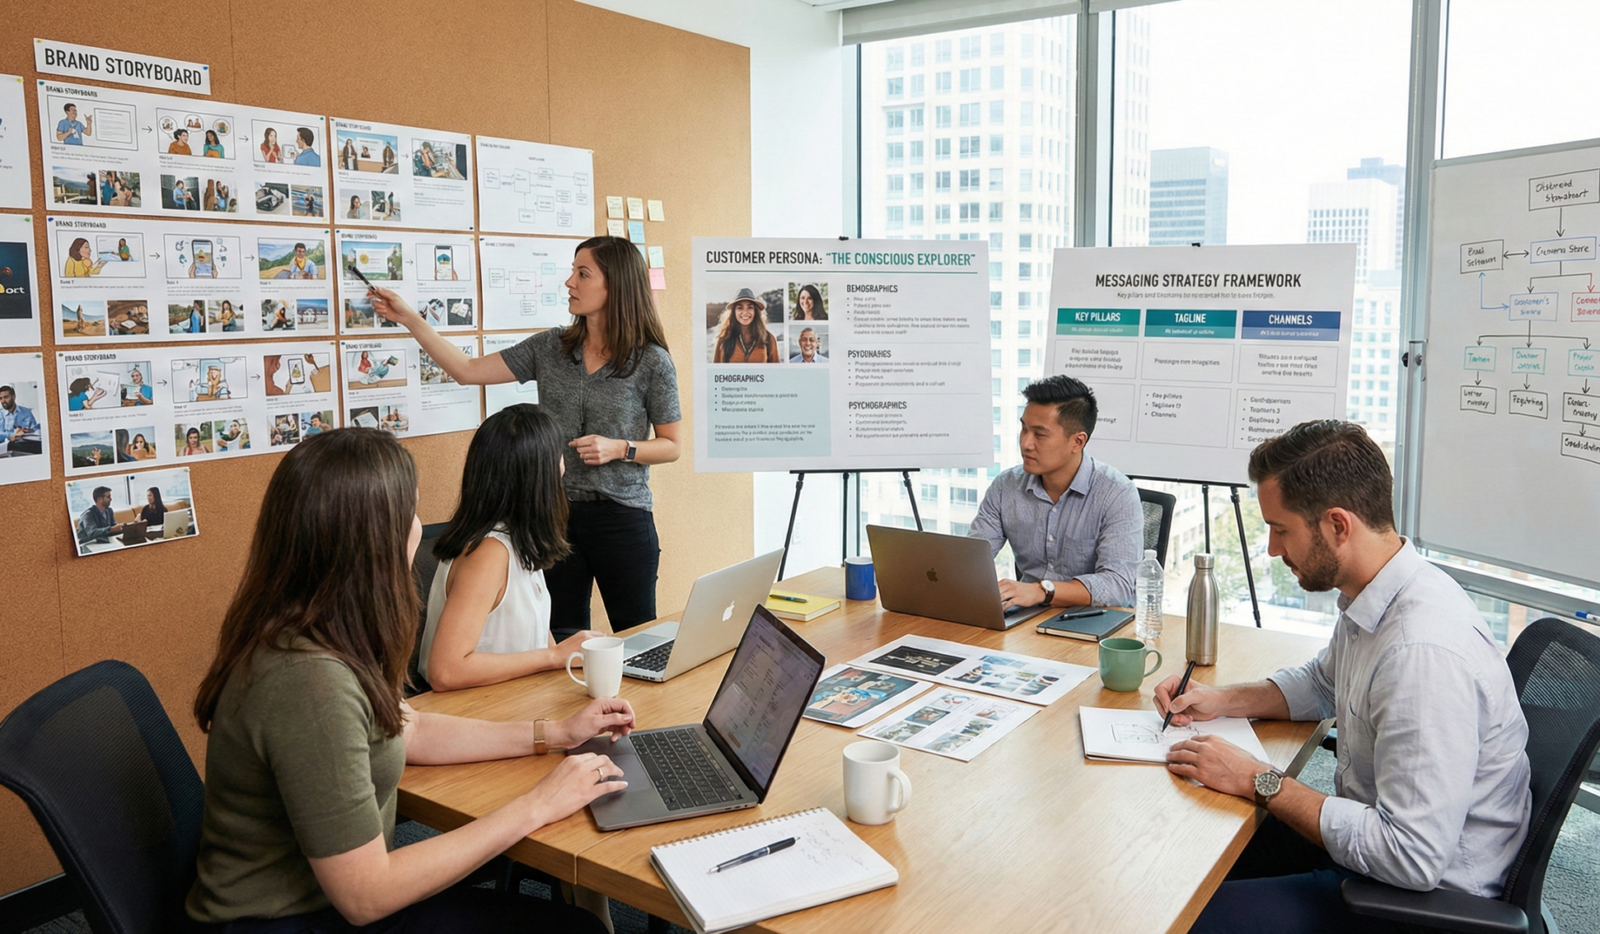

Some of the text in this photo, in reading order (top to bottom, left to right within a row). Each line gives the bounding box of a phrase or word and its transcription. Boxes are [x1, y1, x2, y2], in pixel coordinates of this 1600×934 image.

[44, 48, 202, 86] BRAND STORYBOARD
[706, 251, 767, 265] CUSTOMER
[768, 251, 823, 265] PERSONA:
[854, 252, 915, 266] CONSCIOUS
[1096, 274, 1302, 288] MESSAGING STRATEGY FRAMEWORK
[1075, 312, 1121, 322] KEY PILLARS
[1174, 314, 1206, 323] TAGLINE
[1268, 314, 1312, 325] CHANNELS
[714, 374, 765, 382] DEMOGRAPHICS
[848, 401, 907, 410] PSYCHOGRAPHICS
